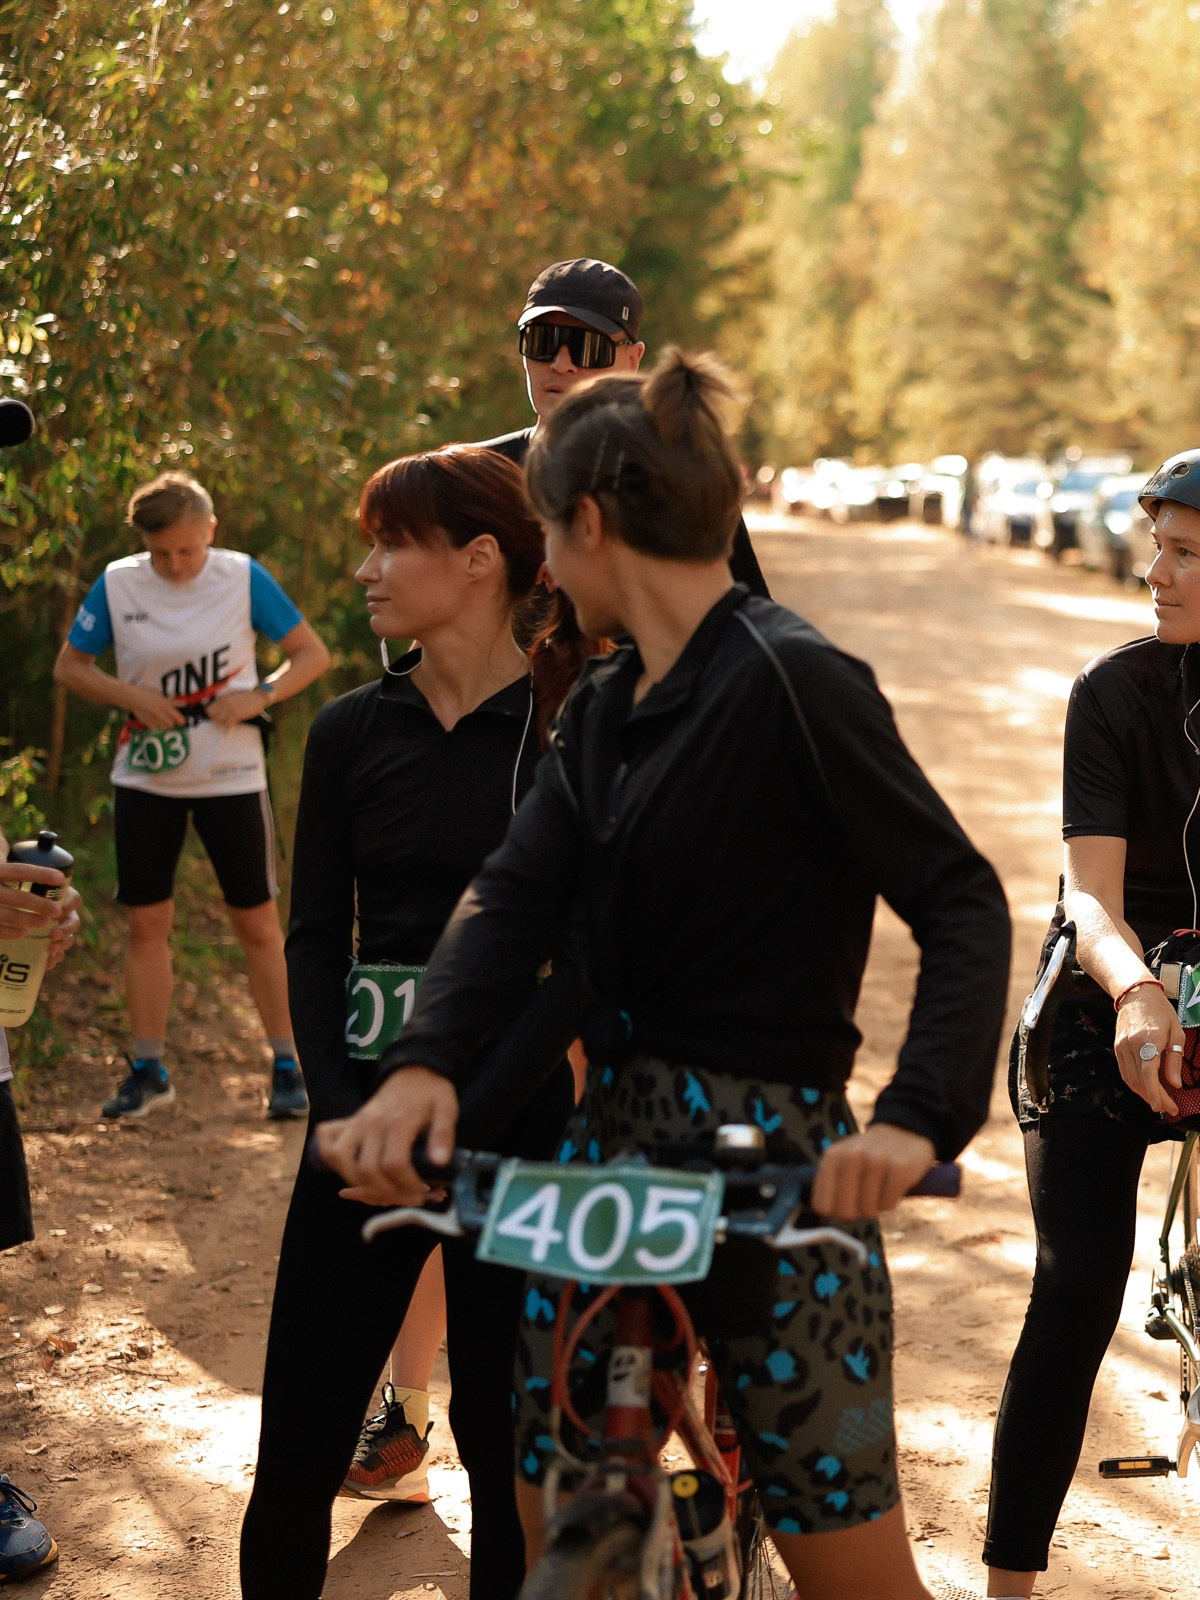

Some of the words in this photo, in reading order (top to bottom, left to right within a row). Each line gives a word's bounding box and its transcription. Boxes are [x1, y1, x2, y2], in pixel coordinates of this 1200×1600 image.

[161, 643, 231, 700] ONE
[131, 730, 188, 771] 203
[496, 1182, 704, 1273] 405
